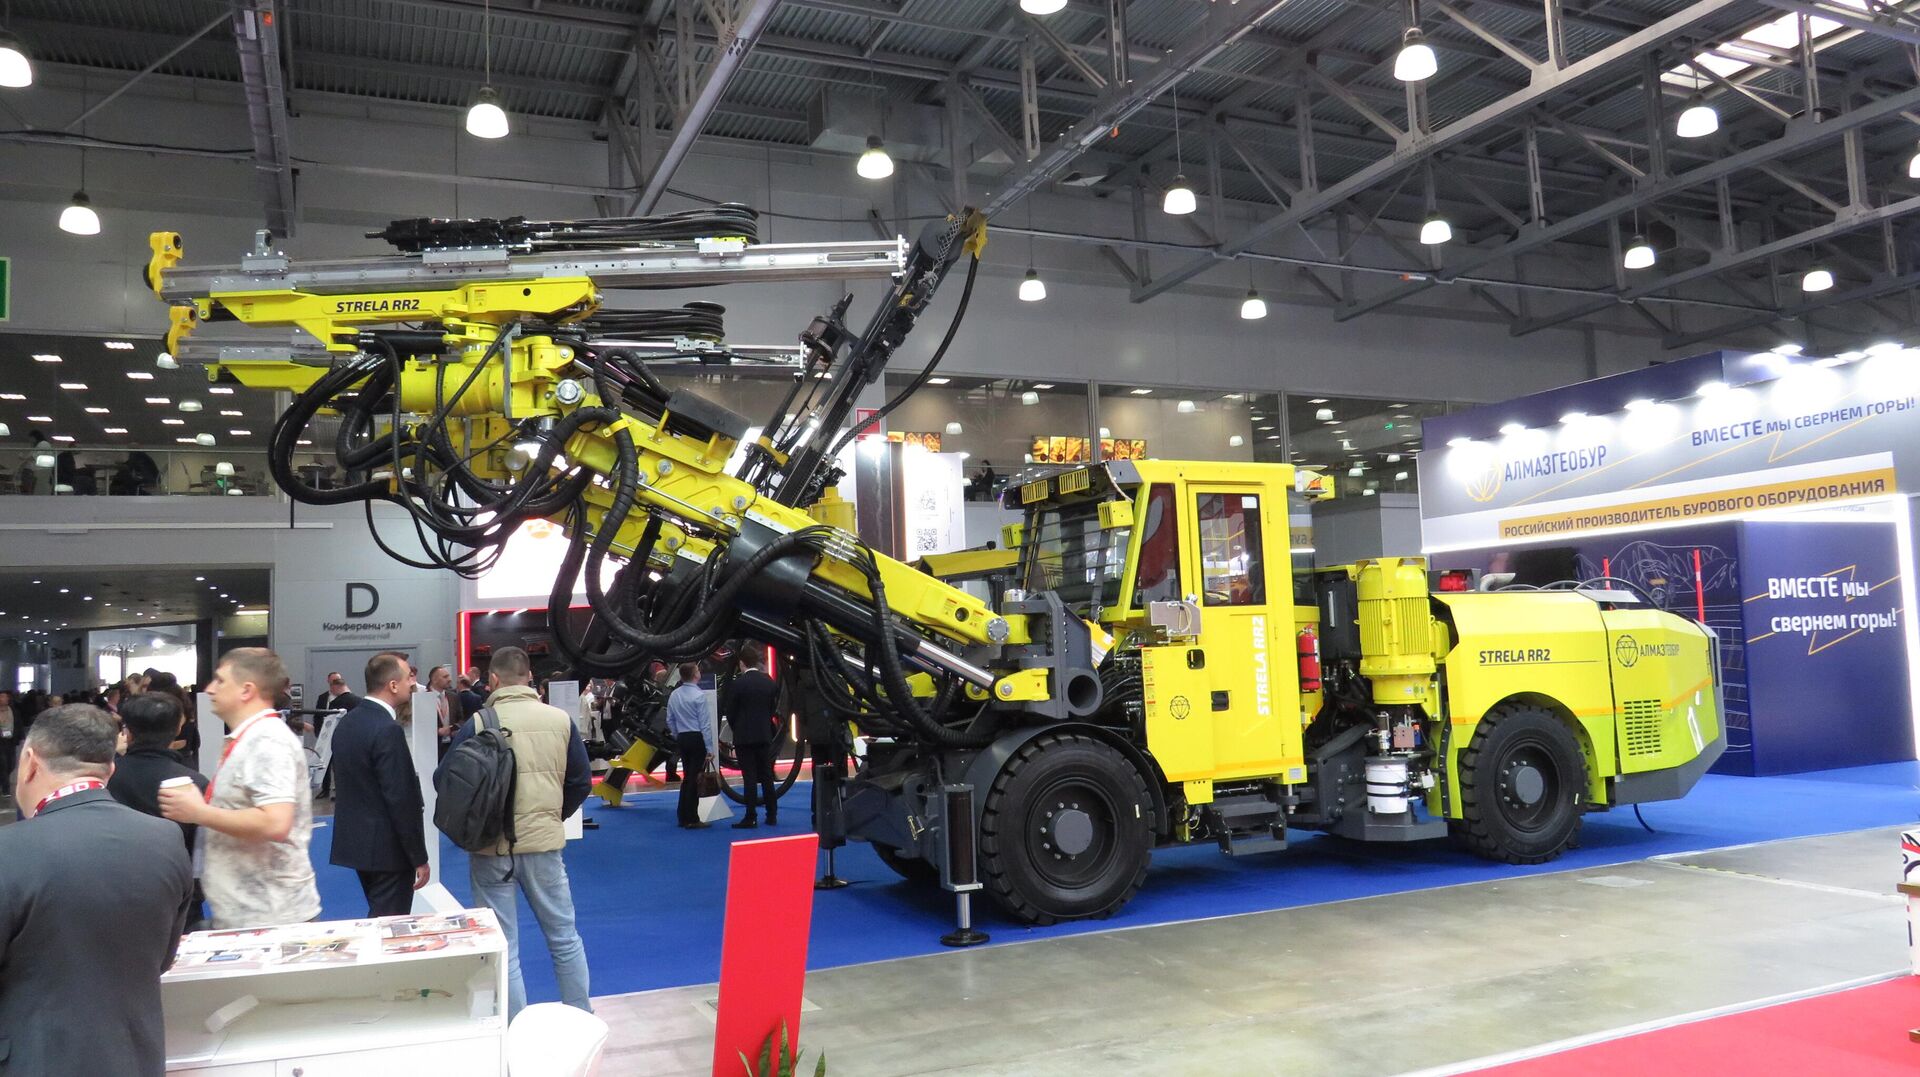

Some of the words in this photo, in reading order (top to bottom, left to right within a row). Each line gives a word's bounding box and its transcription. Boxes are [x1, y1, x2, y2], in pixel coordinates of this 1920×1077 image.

[336, 300, 389, 313] STRELA
[392, 299, 420, 311] RR2
[1691, 420, 1763, 447] ВМЕСТЕ
[1794, 406, 1863, 429] СВЕРНЕМ
[1866, 397, 1915, 416] ГОРЫ!
[1504, 445, 1607, 482] АЛМАЗГЕОБУР
[1504, 517, 1574, 537] РОССИЙСКИЙ
[1576, 506, 1680, 528] ПРОИЗВОДИТЕЛЬ
[1684, 496, 1754, 516] БУРОВОГО
[1757, 479, 1886, 507] ОБОРУДОВАНИЯ
[346, 583, 380, 618] D
[1768, 577, 1839, 599] ВМЕСТЕ
[1252, 616, 1266, 649] RR2
[1771, 614, 1847, 636] свернем
[1850, 608, 1897, 633] горы!
[1479, 650, 1524, 664] STRELA
[1528, 649, 1551, 662] RR2
[1254, 652, 1270, 715] STRELA
